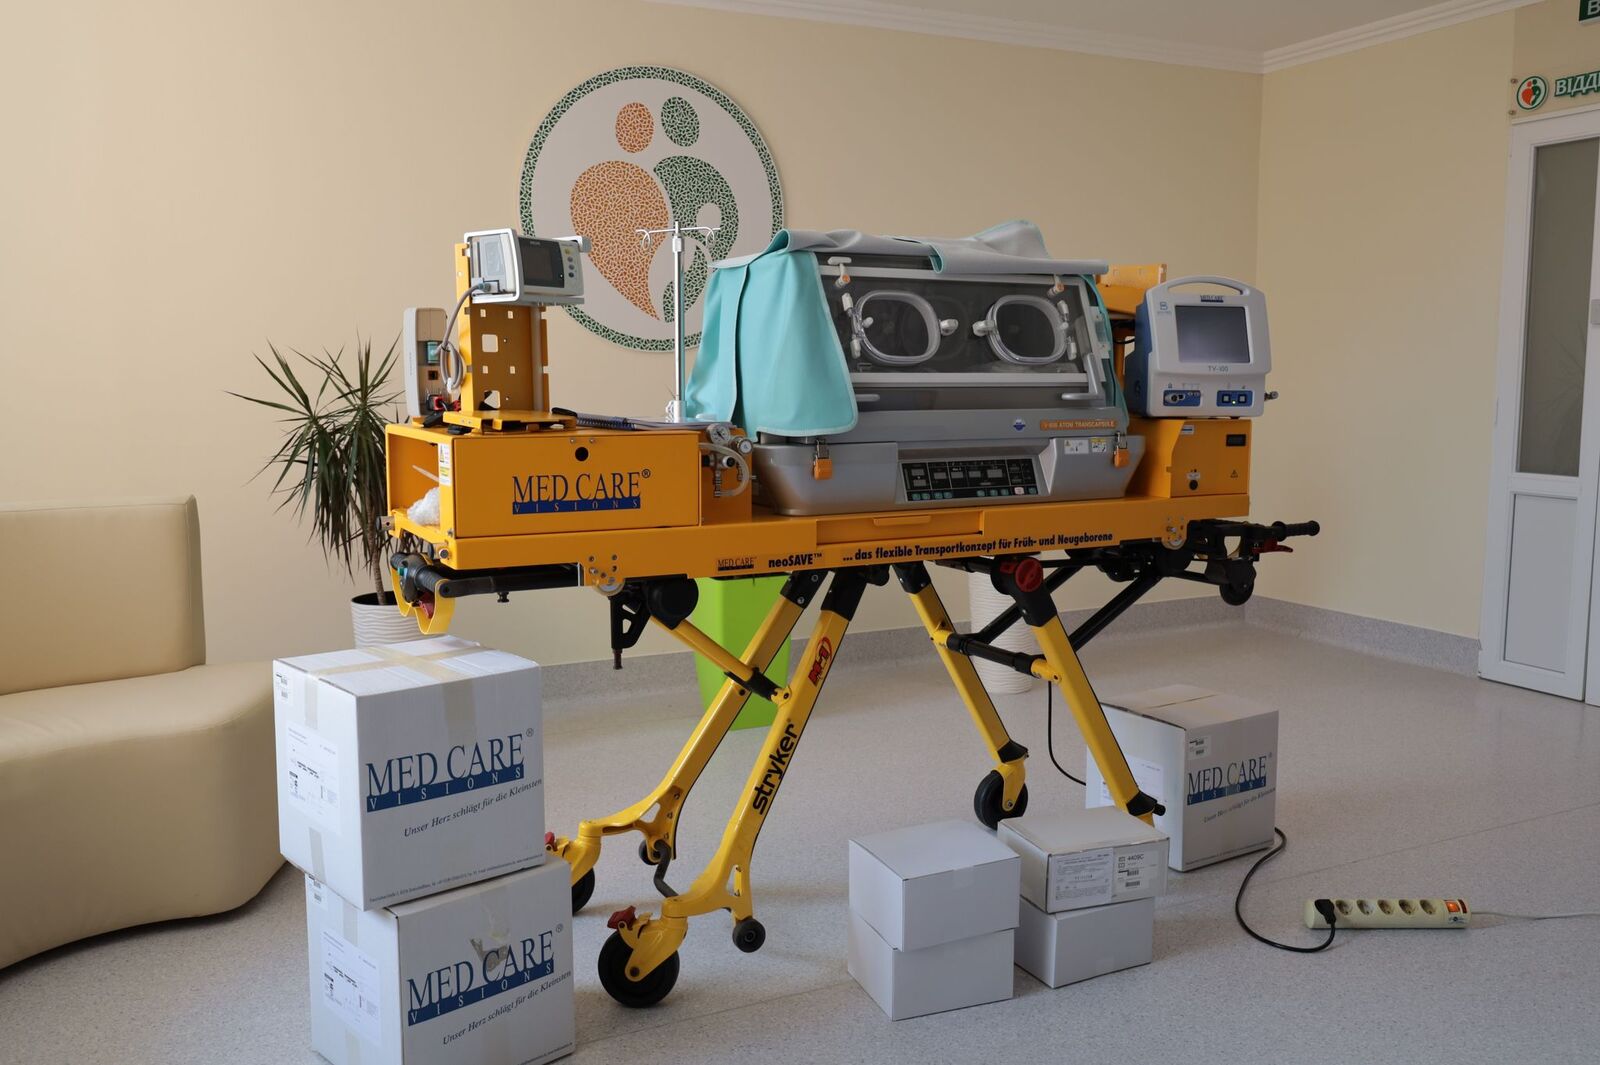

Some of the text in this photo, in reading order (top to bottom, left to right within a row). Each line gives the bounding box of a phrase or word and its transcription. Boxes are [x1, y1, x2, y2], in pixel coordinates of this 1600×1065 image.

[512, 475, 569, 503] MED
[514, 499, 638, 513] VISIONS
[876, 546, 913, 559] flexible
[915, 539, 996, 556] Transportkonzept
[998, 538, 1012, 549] für
[1014, 537, 1037, 547] Früh-
[1039, 535, 1055, 546] und
[1057, 532, 1113, 547] Neugeborene
[366, 752, 438, 797] MED
[370, 766, 521, 810] VISIONS
[1188, 766, 1223, 795] MED
[404, 778, 543, 838] Unser Herz schlägt für die Kleinsten
[407, 960, 474, 1010] MED
[411, 962, 552, 1023] VISIONS
[443, 970, 572, 1045] Unser Herz schlägt für die Kleinsten
